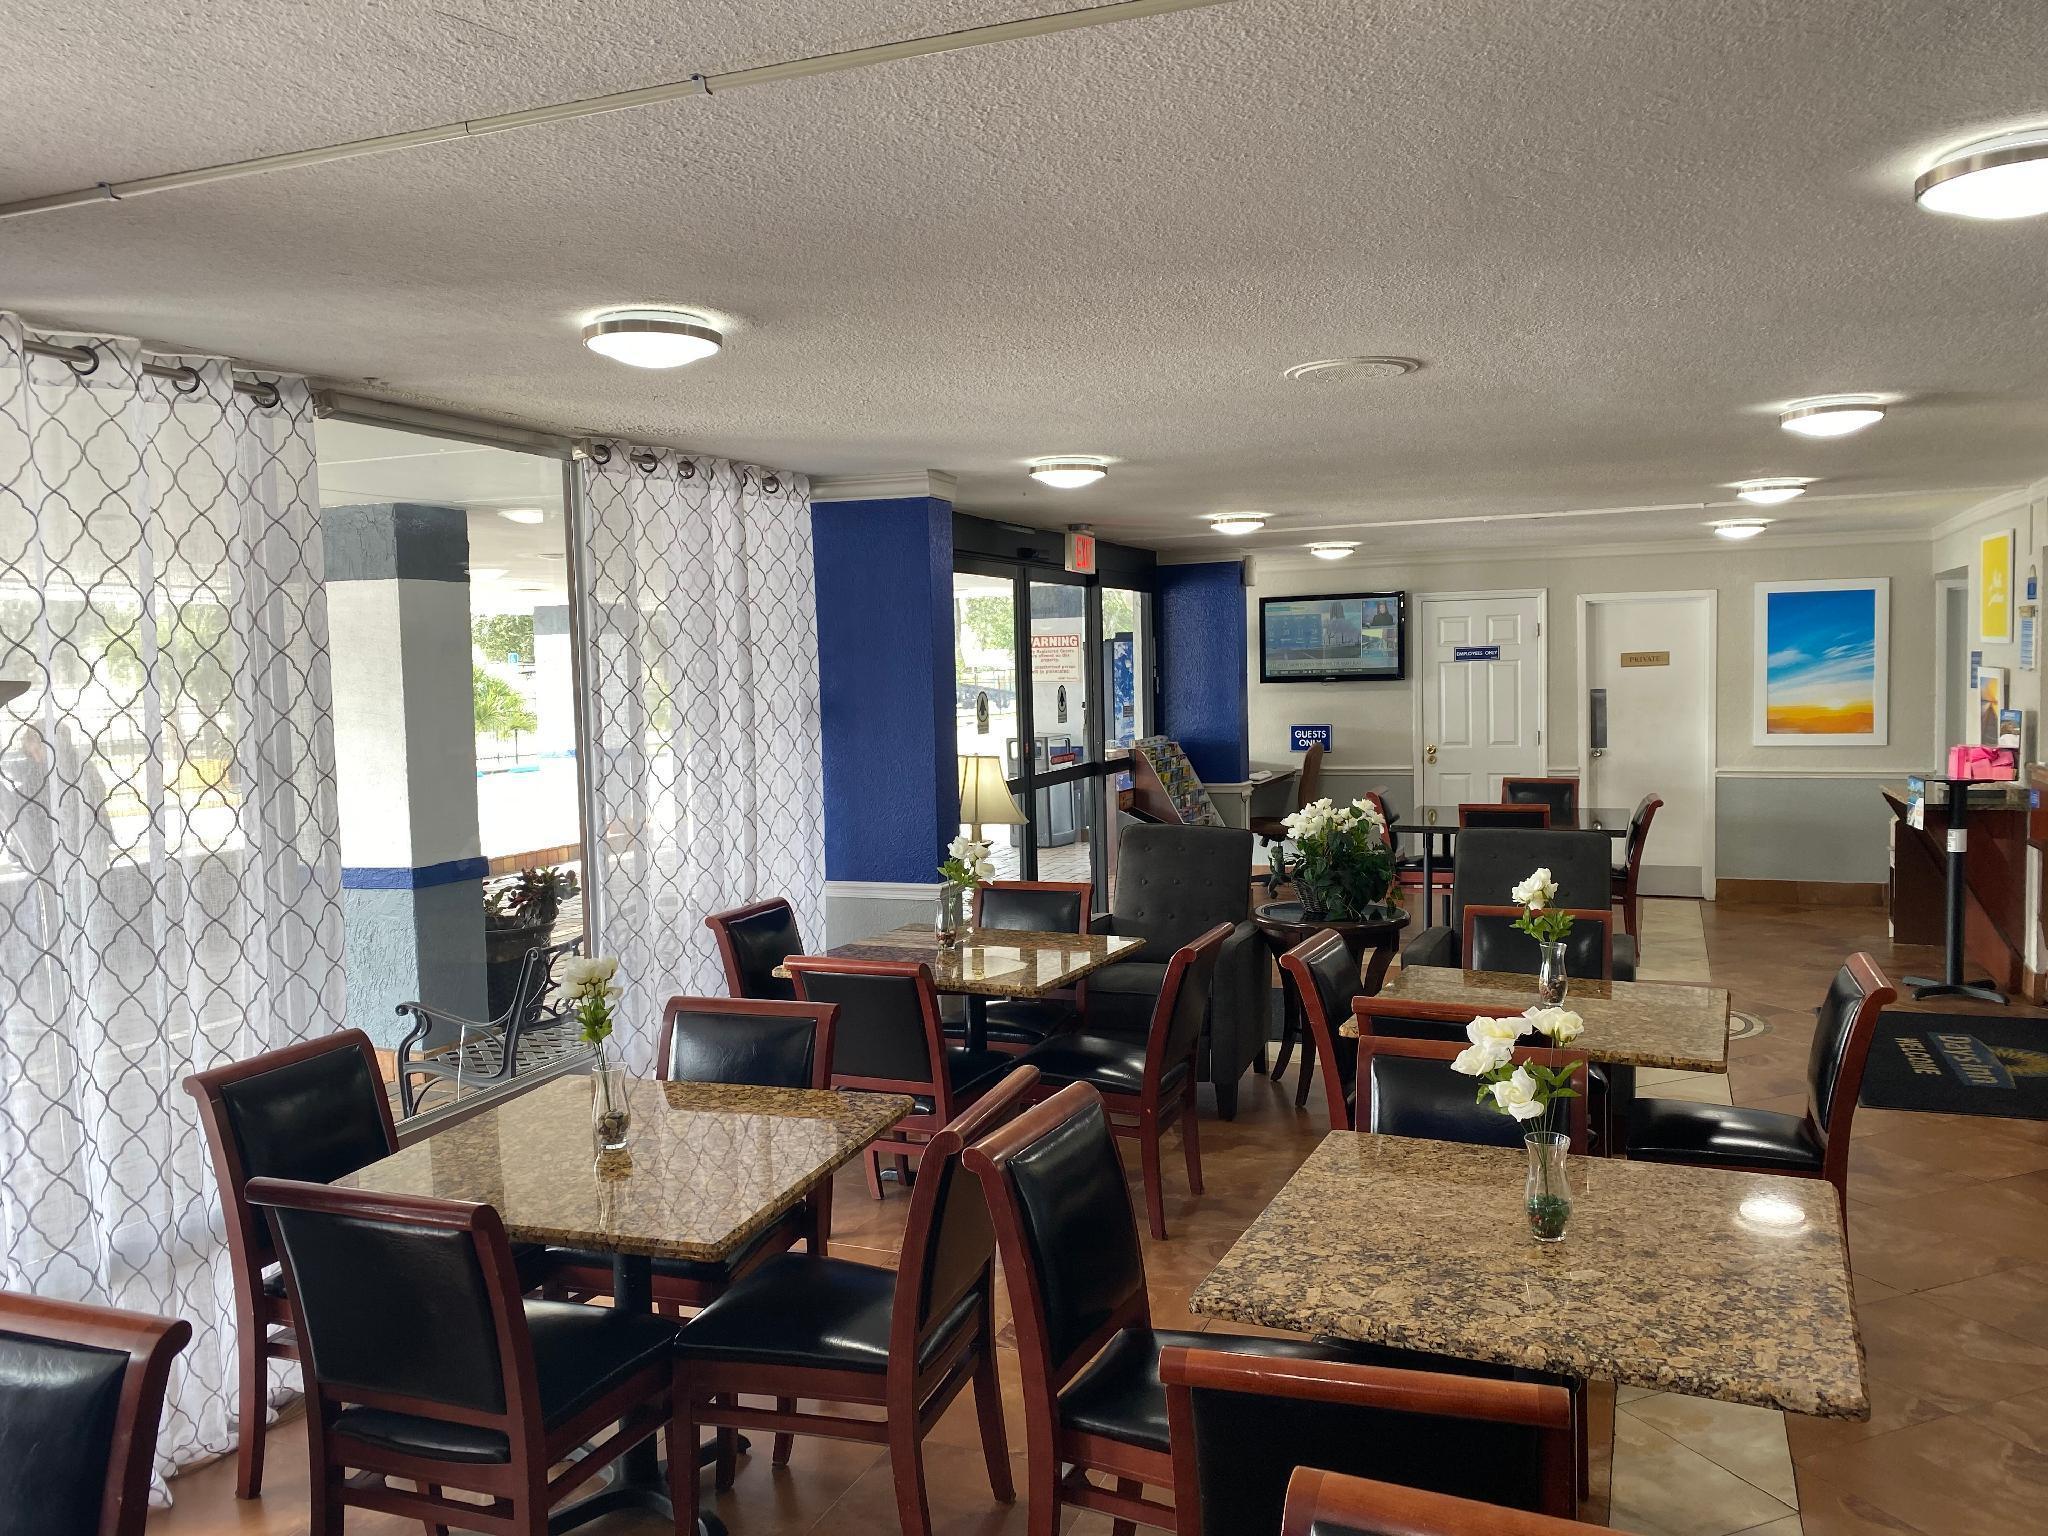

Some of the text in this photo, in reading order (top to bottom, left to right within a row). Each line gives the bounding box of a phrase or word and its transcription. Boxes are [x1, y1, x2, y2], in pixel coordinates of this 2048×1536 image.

[1076, 535, 1094, 569] EXIT
[1031, 635, 1078, 648] ARNING
[1629, 655, 1661, 663] PRIVATE
[1294, 730, 1327, 738] GUESTS
[1893, 1037, 1942, 1076] WELCOME
